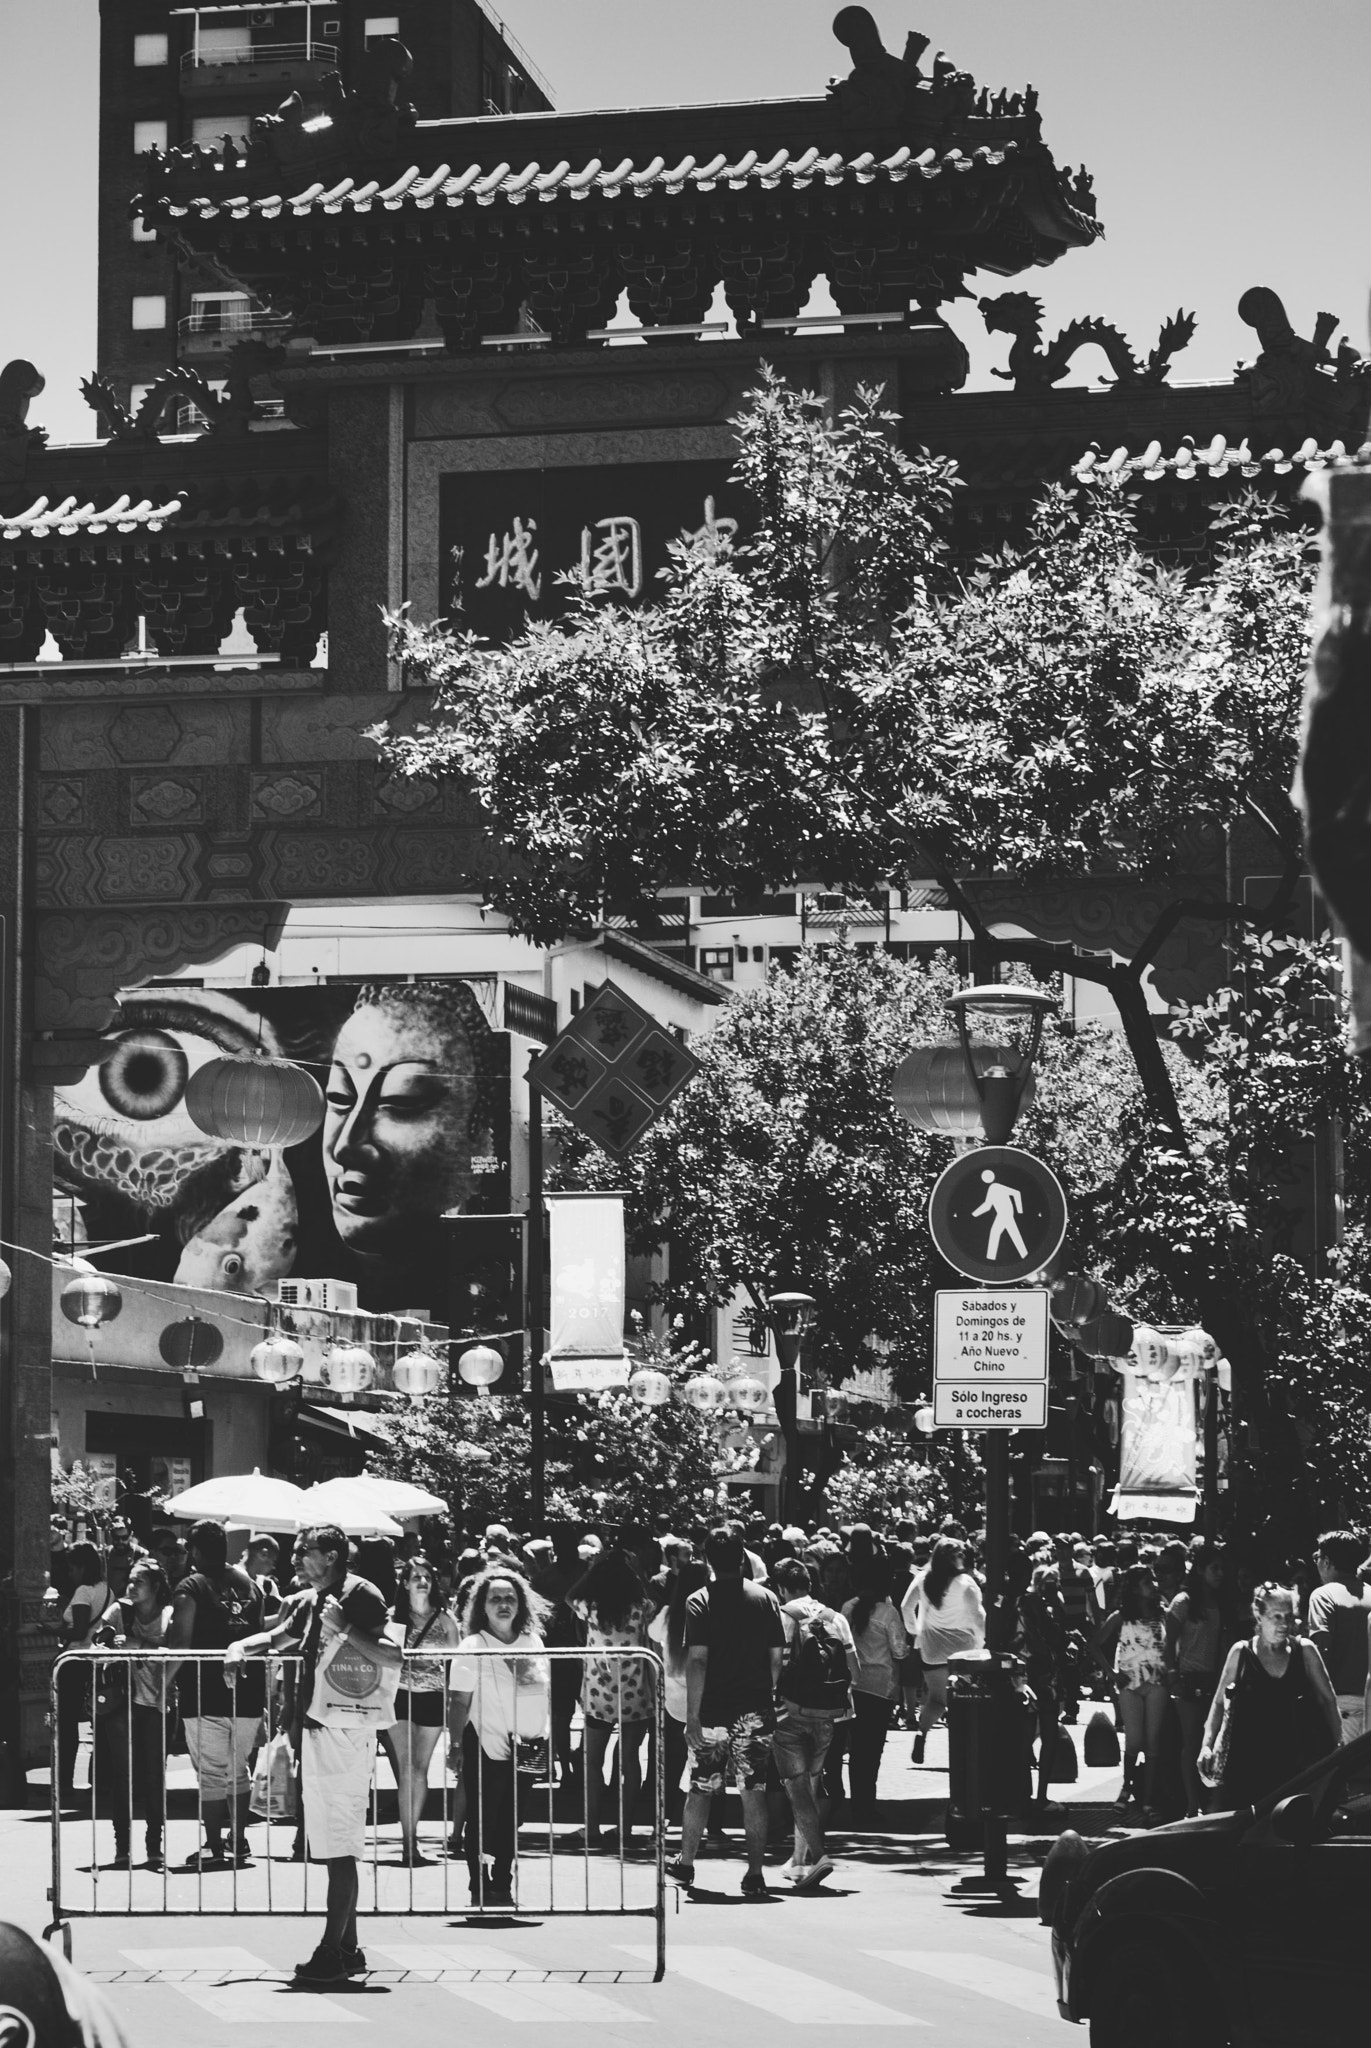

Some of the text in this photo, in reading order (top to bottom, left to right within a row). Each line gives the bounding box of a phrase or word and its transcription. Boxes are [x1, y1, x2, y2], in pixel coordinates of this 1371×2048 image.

[568, 1307, 608, 1319] 2017
[962, 1300, 1017, 1314] Sábados y
[956, 1315, 1026, 1328] Domingos de
[959, 1331, 1023, 1344] 11 a 20 hs. y
[961, 1345, 1020, 1357] Año Nuevo
[974, 1360, 1006, 1372] Chino
[951, 1389, 1028, 1406] Sólo Ingreso
[956, 1407, 1022, 1418] a cocheras
[331, 1663, 353, 1673] TINA
